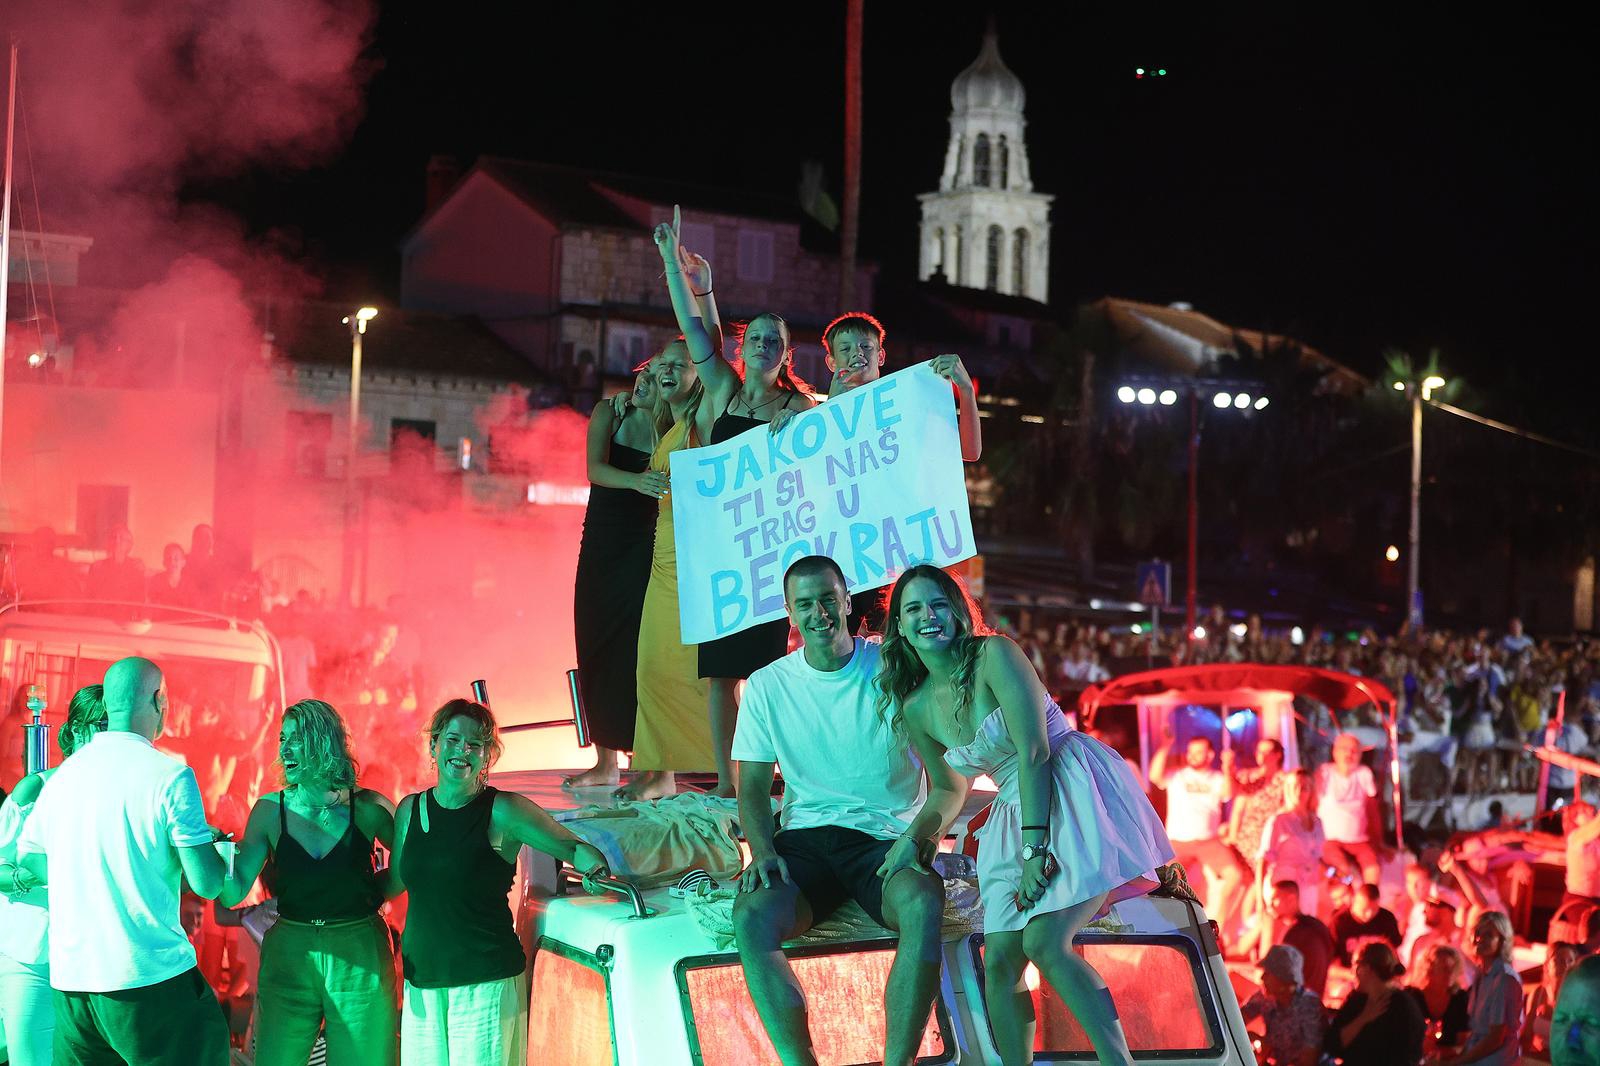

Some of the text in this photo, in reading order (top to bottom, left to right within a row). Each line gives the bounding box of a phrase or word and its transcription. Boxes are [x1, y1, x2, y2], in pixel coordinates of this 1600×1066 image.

[696, 379, 902, 498] JAKOVE
[723, 427, 899, 527] TI SI NAŠ
[734, 483, 860, 559] TRAG U
